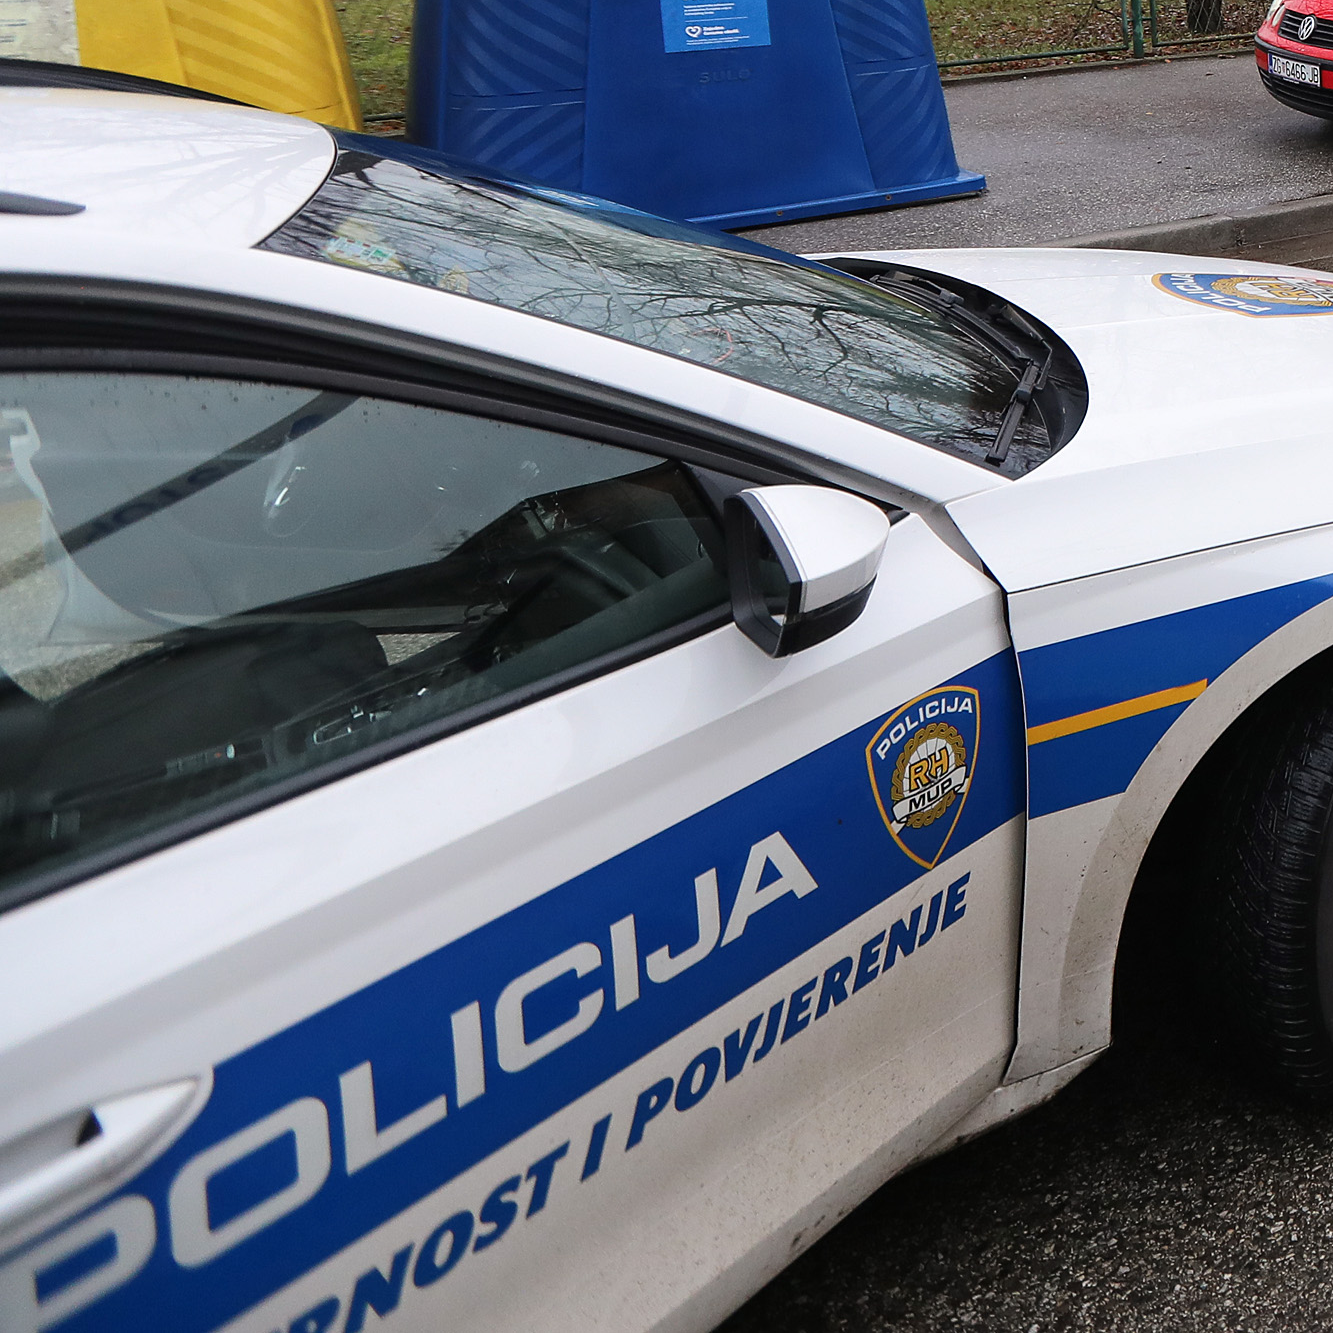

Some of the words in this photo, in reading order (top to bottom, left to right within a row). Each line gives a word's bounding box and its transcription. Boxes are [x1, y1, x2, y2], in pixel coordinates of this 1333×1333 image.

[1272, 57, 1282, 74] ZG
[876, 696, 974, 760] POLICIJA
[908, 746, 951, 792] RH
[908, 776, 953, 813] MUP
[580, 1114, 612, 1183] I
[624, 870, 972, 1153] POVJERENJE
[0, 831, 819, 1333] POLICIJA
